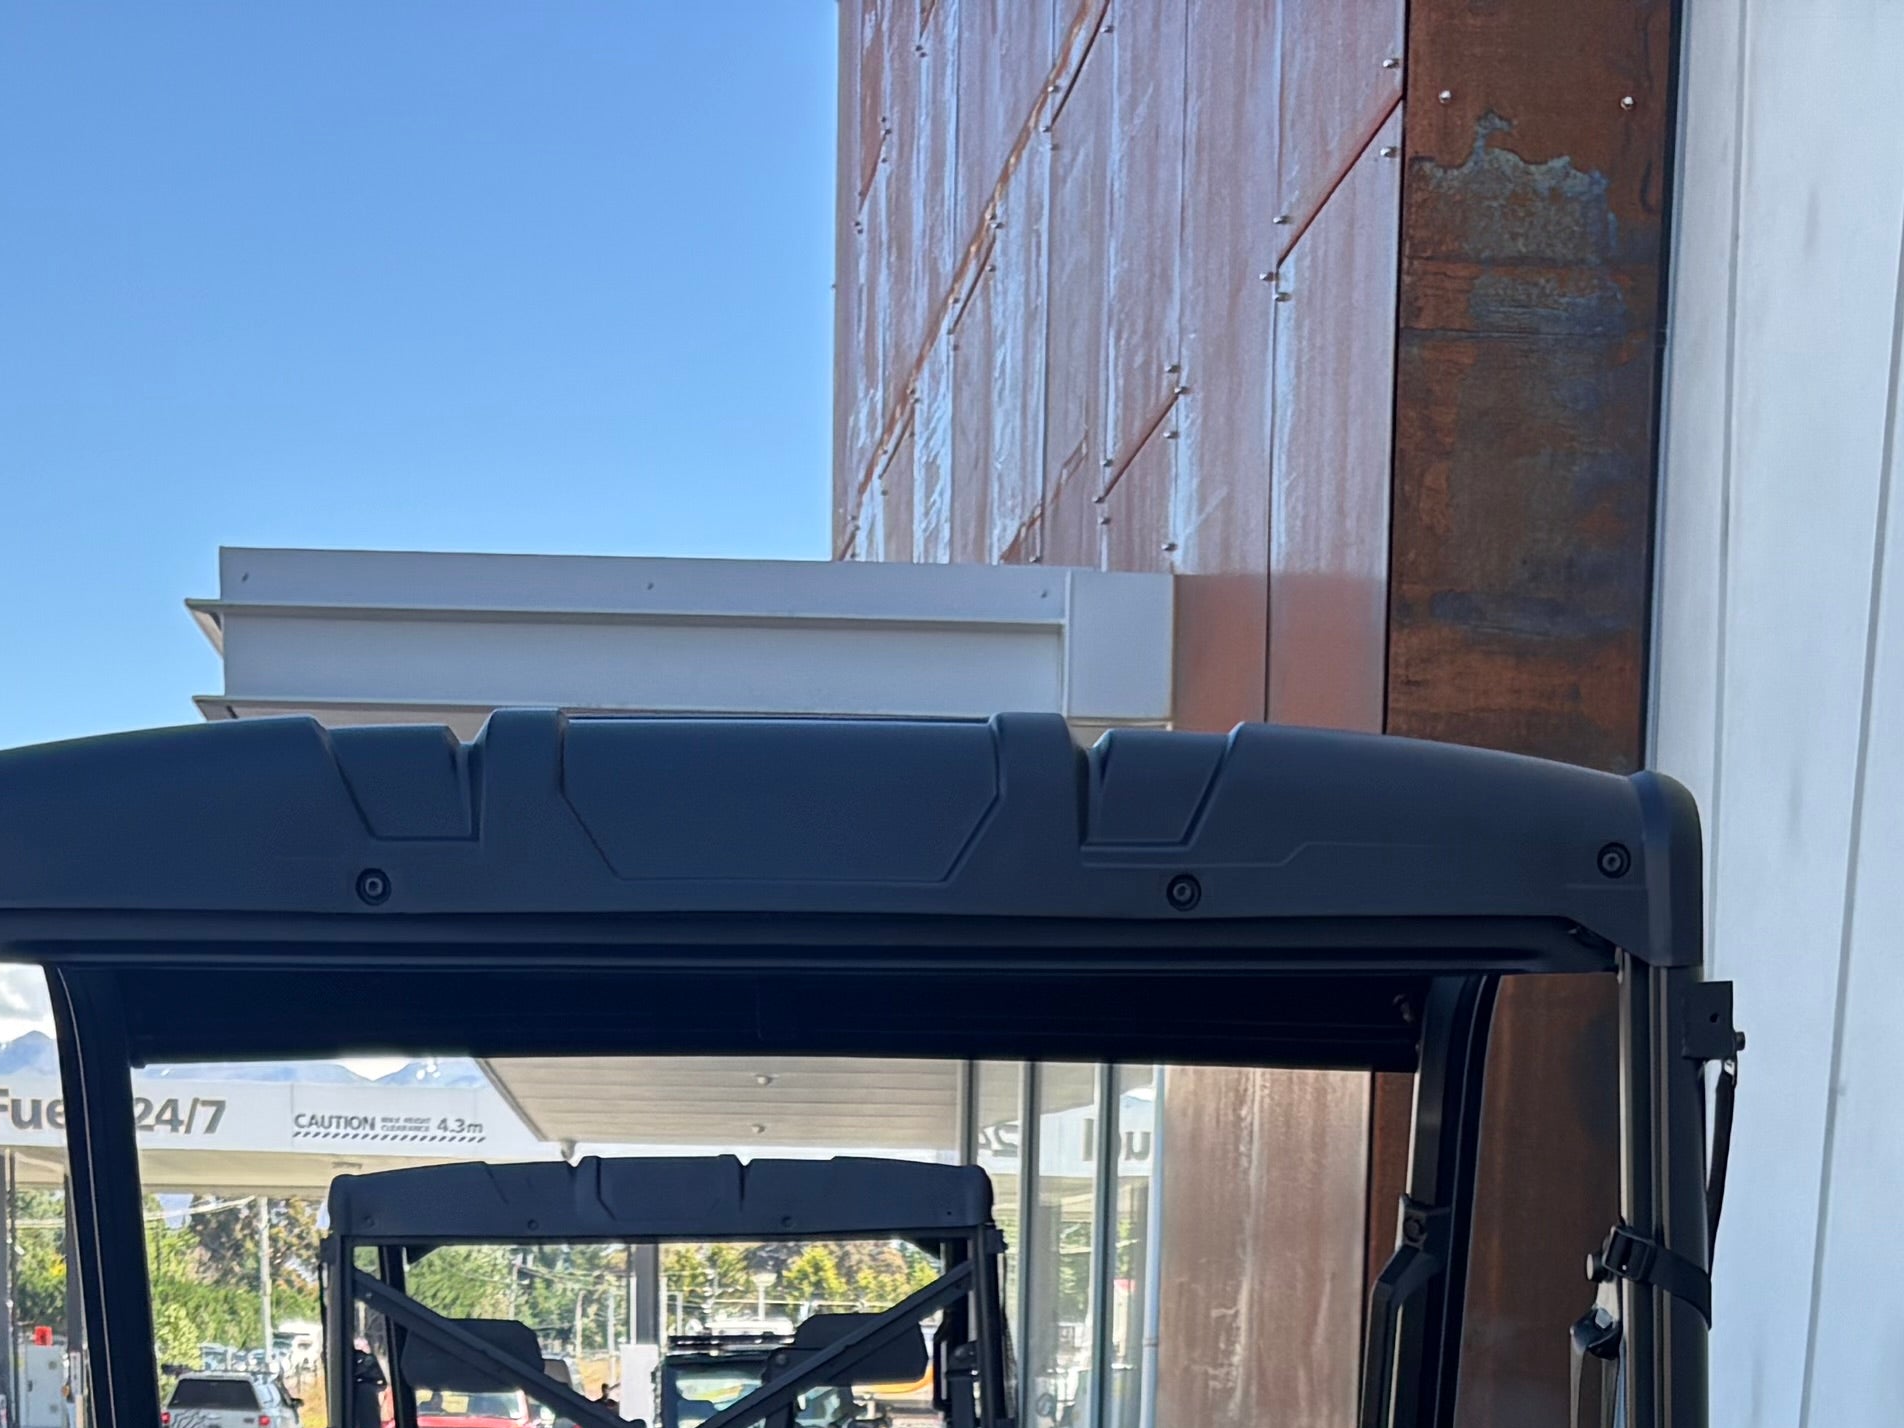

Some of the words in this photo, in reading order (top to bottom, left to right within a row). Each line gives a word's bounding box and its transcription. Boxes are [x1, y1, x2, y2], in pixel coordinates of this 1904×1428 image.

[133, 1097, 227, 1135] 24/7
[294, 1113, 376, 1131] CAUTION
[437, 1117, 484, 1134] 4.3m
